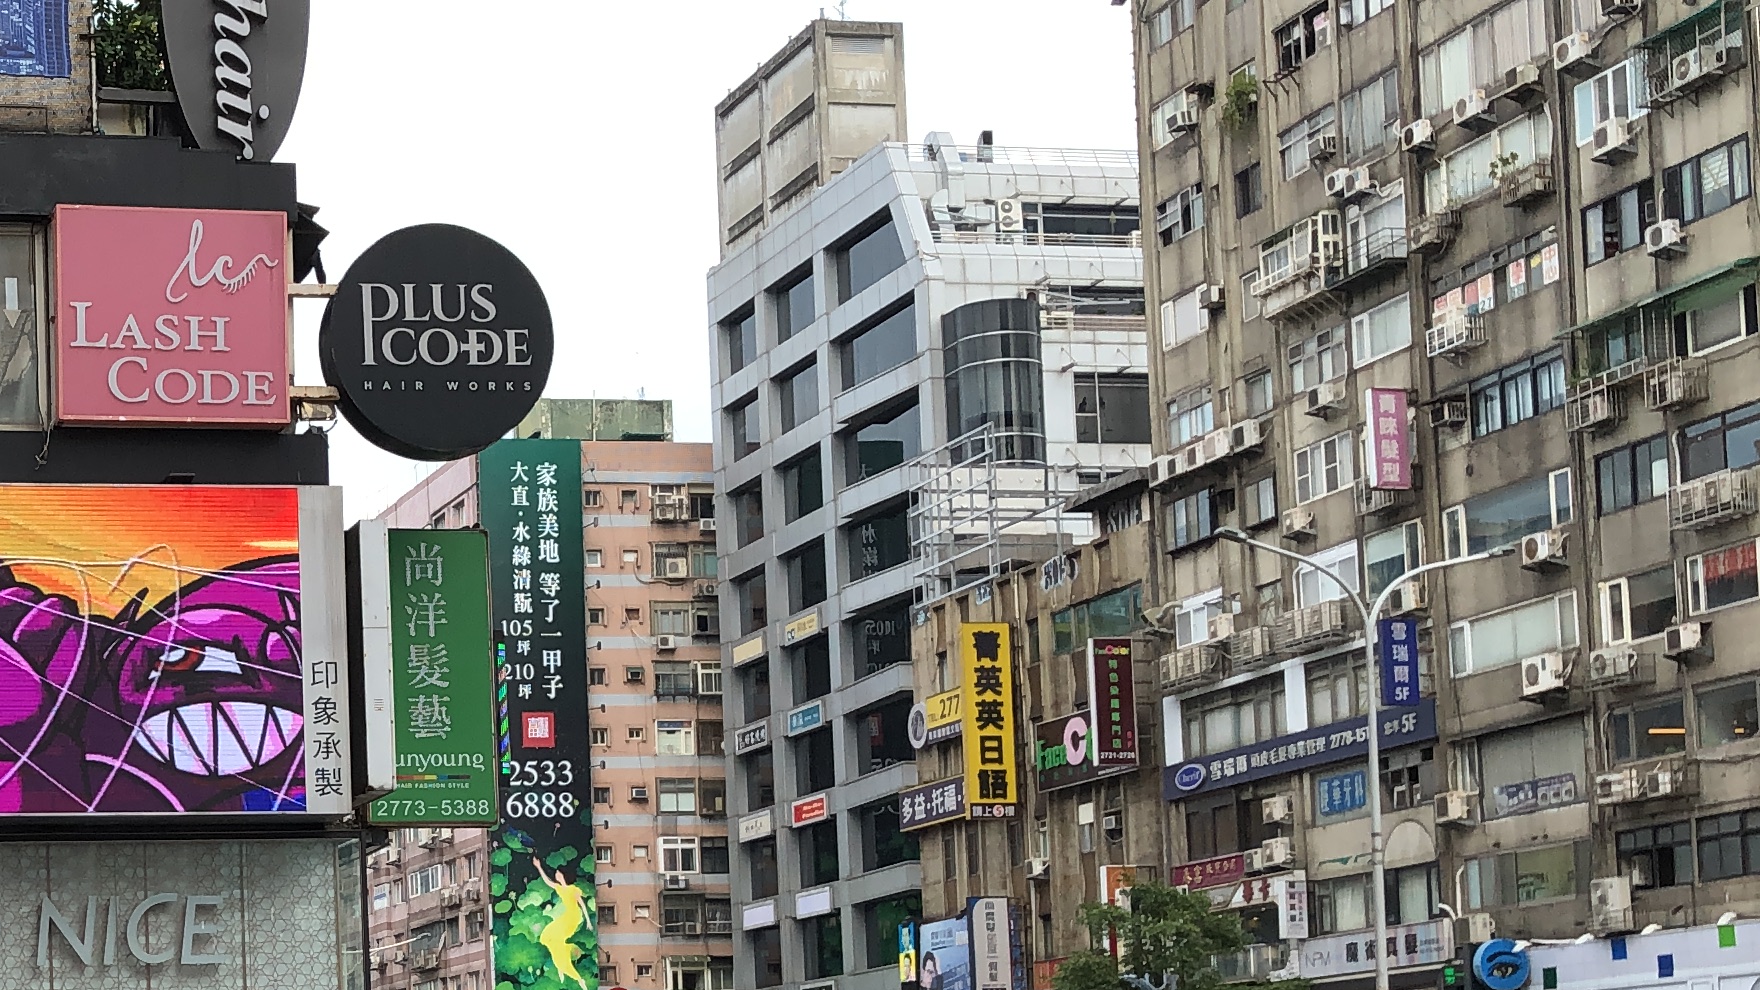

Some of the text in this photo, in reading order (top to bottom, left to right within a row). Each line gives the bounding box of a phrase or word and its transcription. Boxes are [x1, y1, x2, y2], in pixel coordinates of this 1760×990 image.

[364, 380, 532, 391] HAIR WORKS
[536, 462, 564, 700] 家族美地 等了一甲子
[501, 619, 533, 637] 105
[404, 541, 452, 740] 尚洋髮藝
[516, 640, 532, 657] 坪
[504, 663, 535, 681] 210
[518, 684, 533, 701] 坪
[1394, 686, 1410, 701] 5F
[310, 659, 344, 797] 印象承製
[396, 752, 486, 773] unyoung
[509, 760, 573, 786] 2533
[376, 799, 490, 817] 2773-5388
[505, 791, 575, 818] 6888
[901, 782, 966, 825] 多益·托福·
[36, 892, 227, 967] NICE
